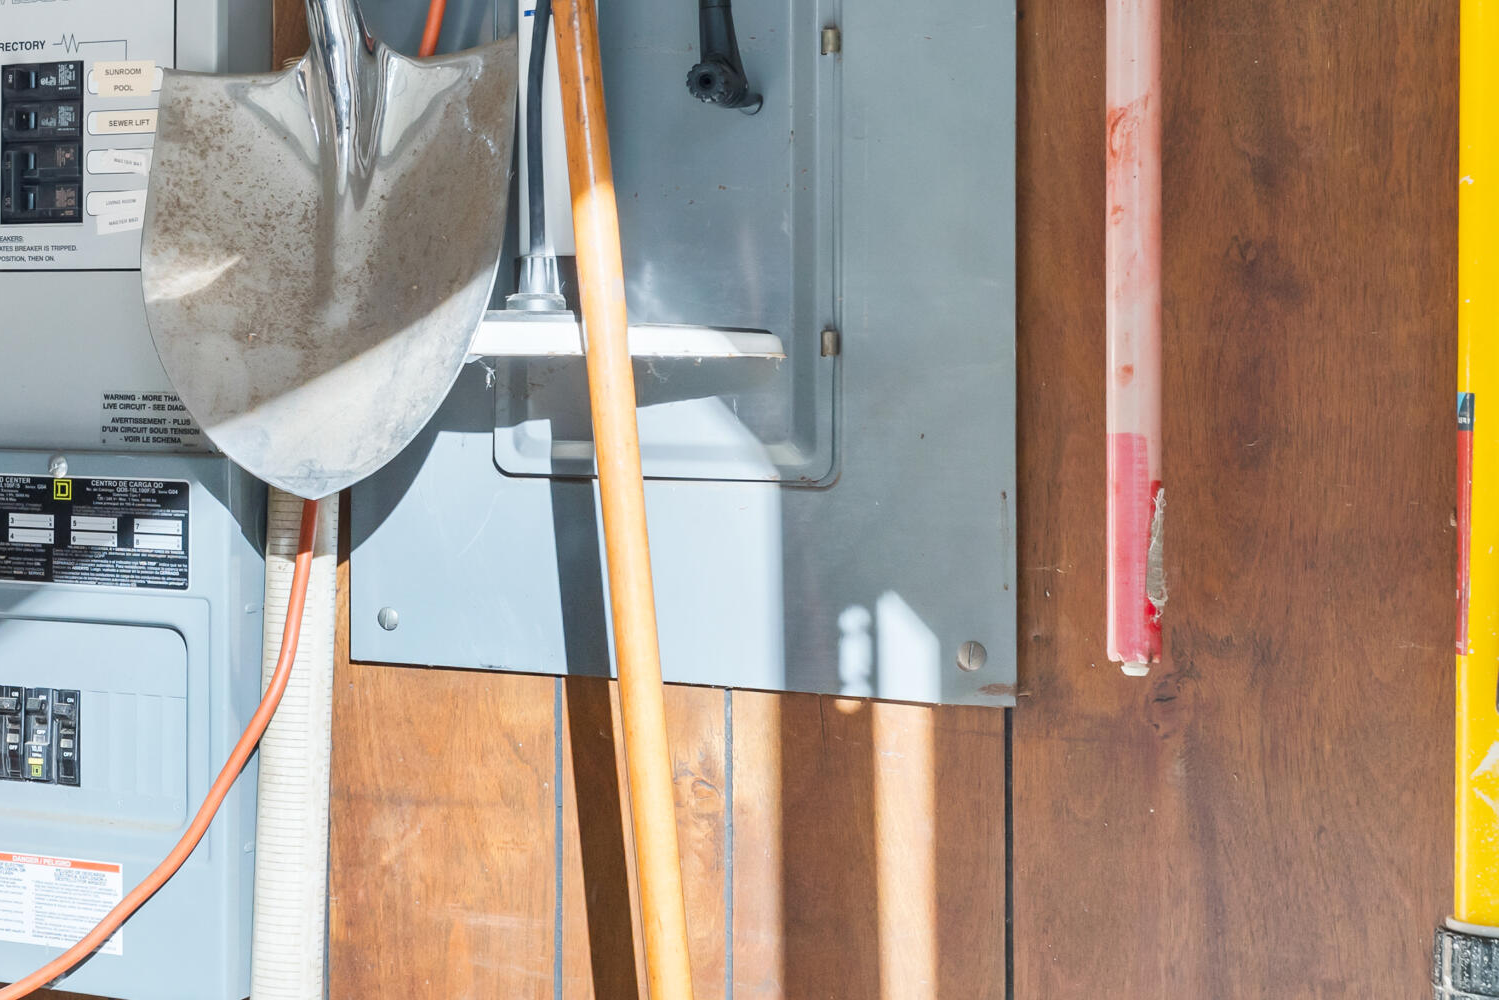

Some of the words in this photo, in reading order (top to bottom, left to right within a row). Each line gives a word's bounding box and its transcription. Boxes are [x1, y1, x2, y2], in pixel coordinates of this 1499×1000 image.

[105, 68, 142, 76] SUNROOM
[114, 84, 133, 92] POOL
[103, 393, 136, 401] WARNING
[111, 417, 166, 425] AVERTISSEMENT
